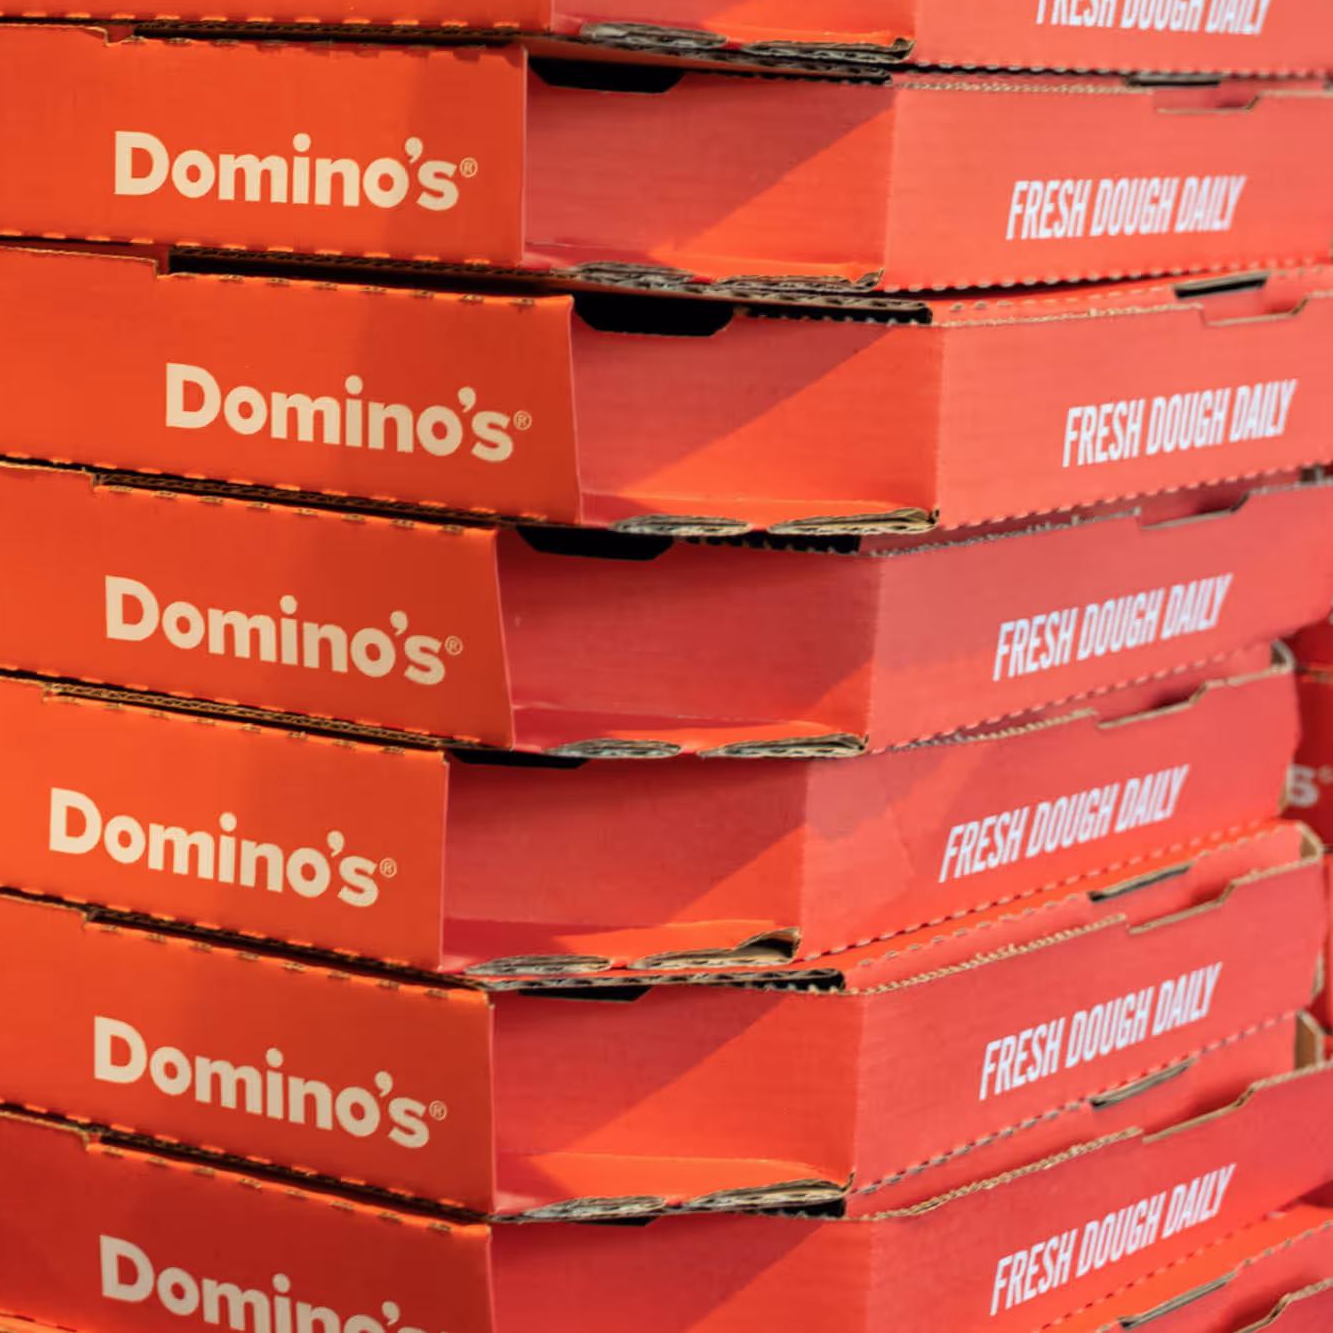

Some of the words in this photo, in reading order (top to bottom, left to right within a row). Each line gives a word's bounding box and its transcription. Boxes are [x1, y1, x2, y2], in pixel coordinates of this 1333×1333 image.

[1005, 179, 1093, 240] FRESH
[1089, 177, 1180, 237] DOUGH
[1174, 175, 1247, 233] DAILY
[1062, 398, 1146, 468] FRESH
[1146, 388, 1231, 455] DOUGH
[1229, 378, 1298, 443] DAILY
[992, 607, 1079, 682] FRESH
[1076, 587, 1166, 661] DOUGH
[1160, 572, 1233, 640] DAILY
[938, 806, 1030, 884] FRESH
[1026, 782, 1121, 858] DOUGH
[1114, 763, 1190, 833] DAILY
[979, 1017, 1066, 1101] FRESH
[1064, 985, 1155, 1069] DOUGH
[1151, 961, 1223, 1037] DAILY
[990, 1227, 1079, 1316] FRESH
[1076, 1191, 1167, 1279] DOUGH
[1161, 1162, 1237, 1240] DAILY
